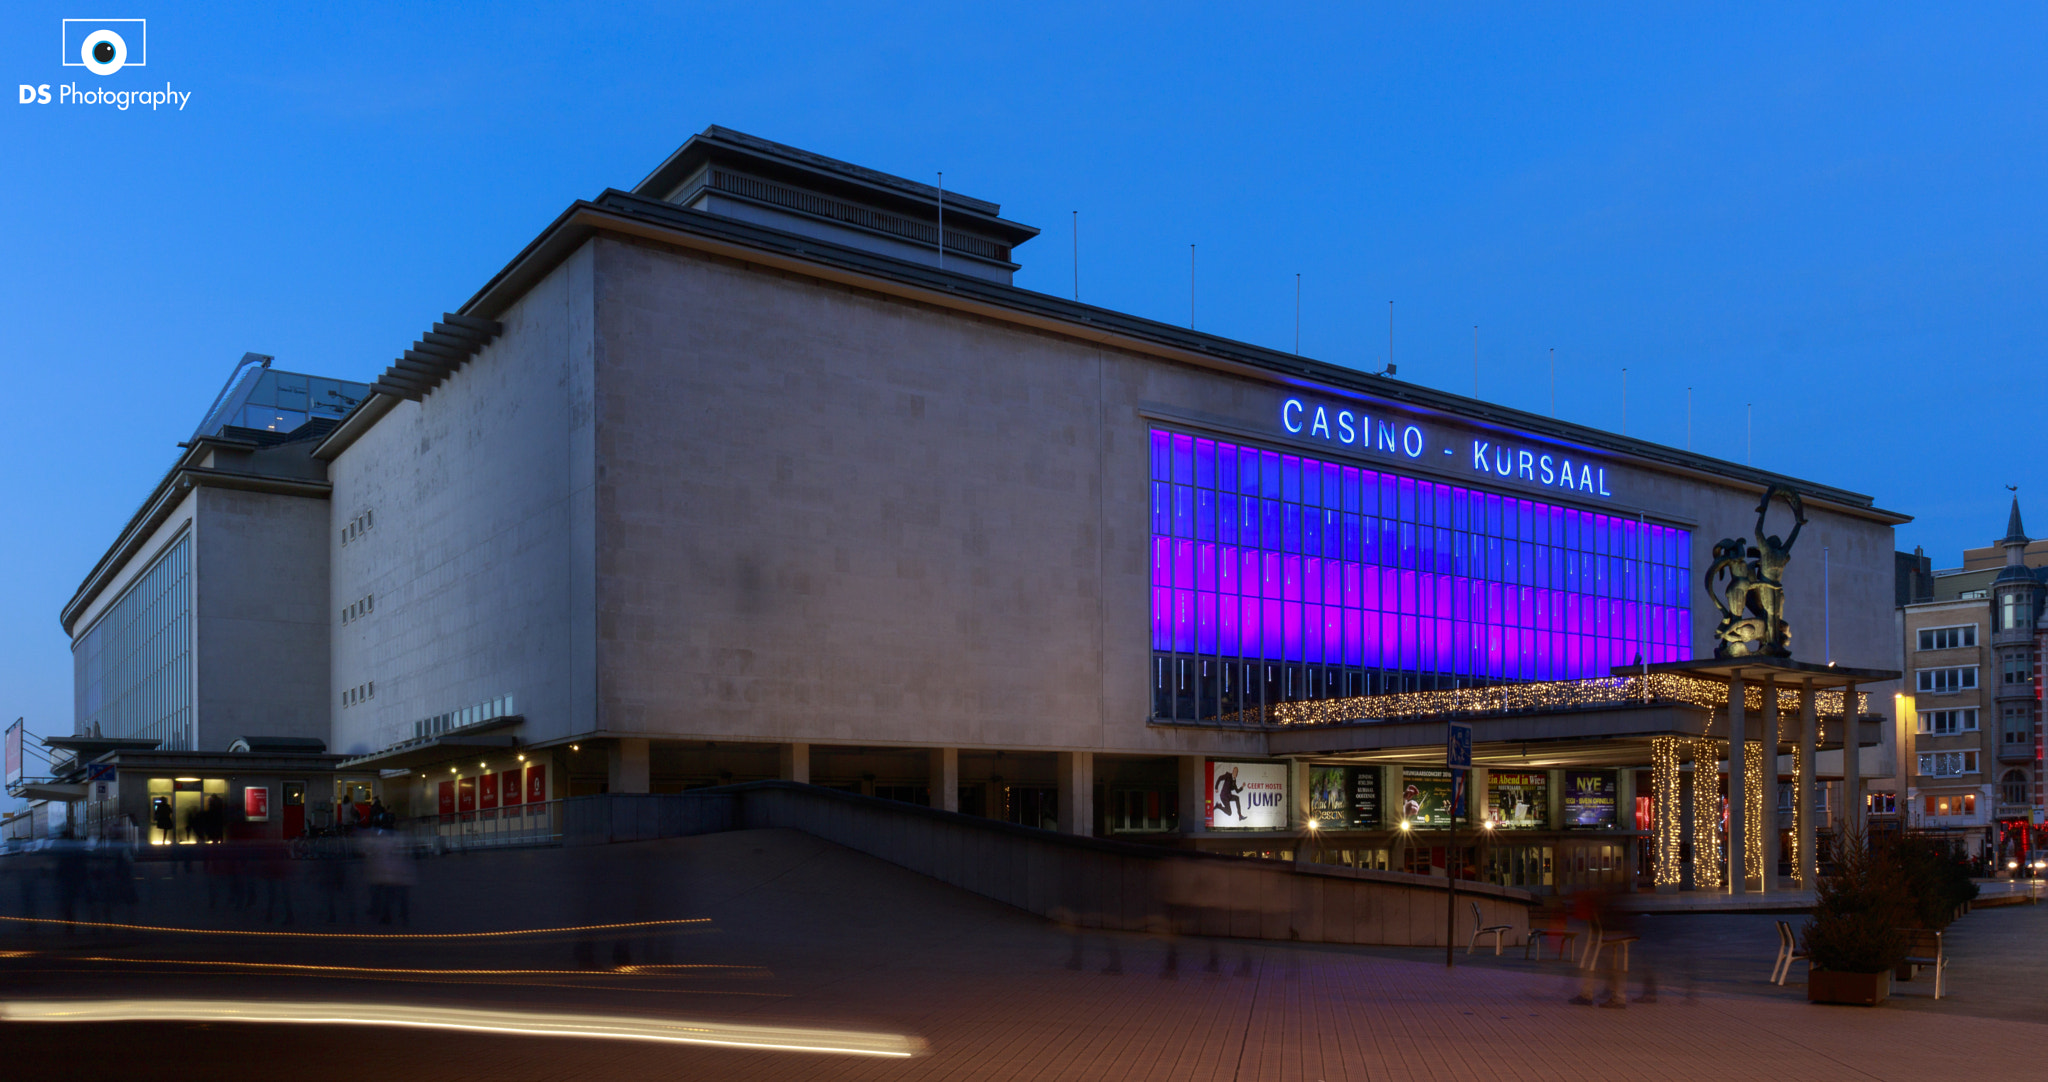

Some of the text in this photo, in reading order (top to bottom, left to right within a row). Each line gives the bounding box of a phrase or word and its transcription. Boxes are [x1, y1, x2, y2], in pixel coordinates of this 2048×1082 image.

[1283, 399, 1423, 458] CASINO
[1473, 440, 1612, 497] KURSAAL
[1247, 782, 1283, 791] GEERT HOSTE
[1499, 774, 1520, 785] Abend
[1521, 775, 1529, 785] in
[1529, 775, 1546, 785] Wien
[1576, 777, 1602, 792] NYE
[1247, 791, 1283, 810] JUMP
